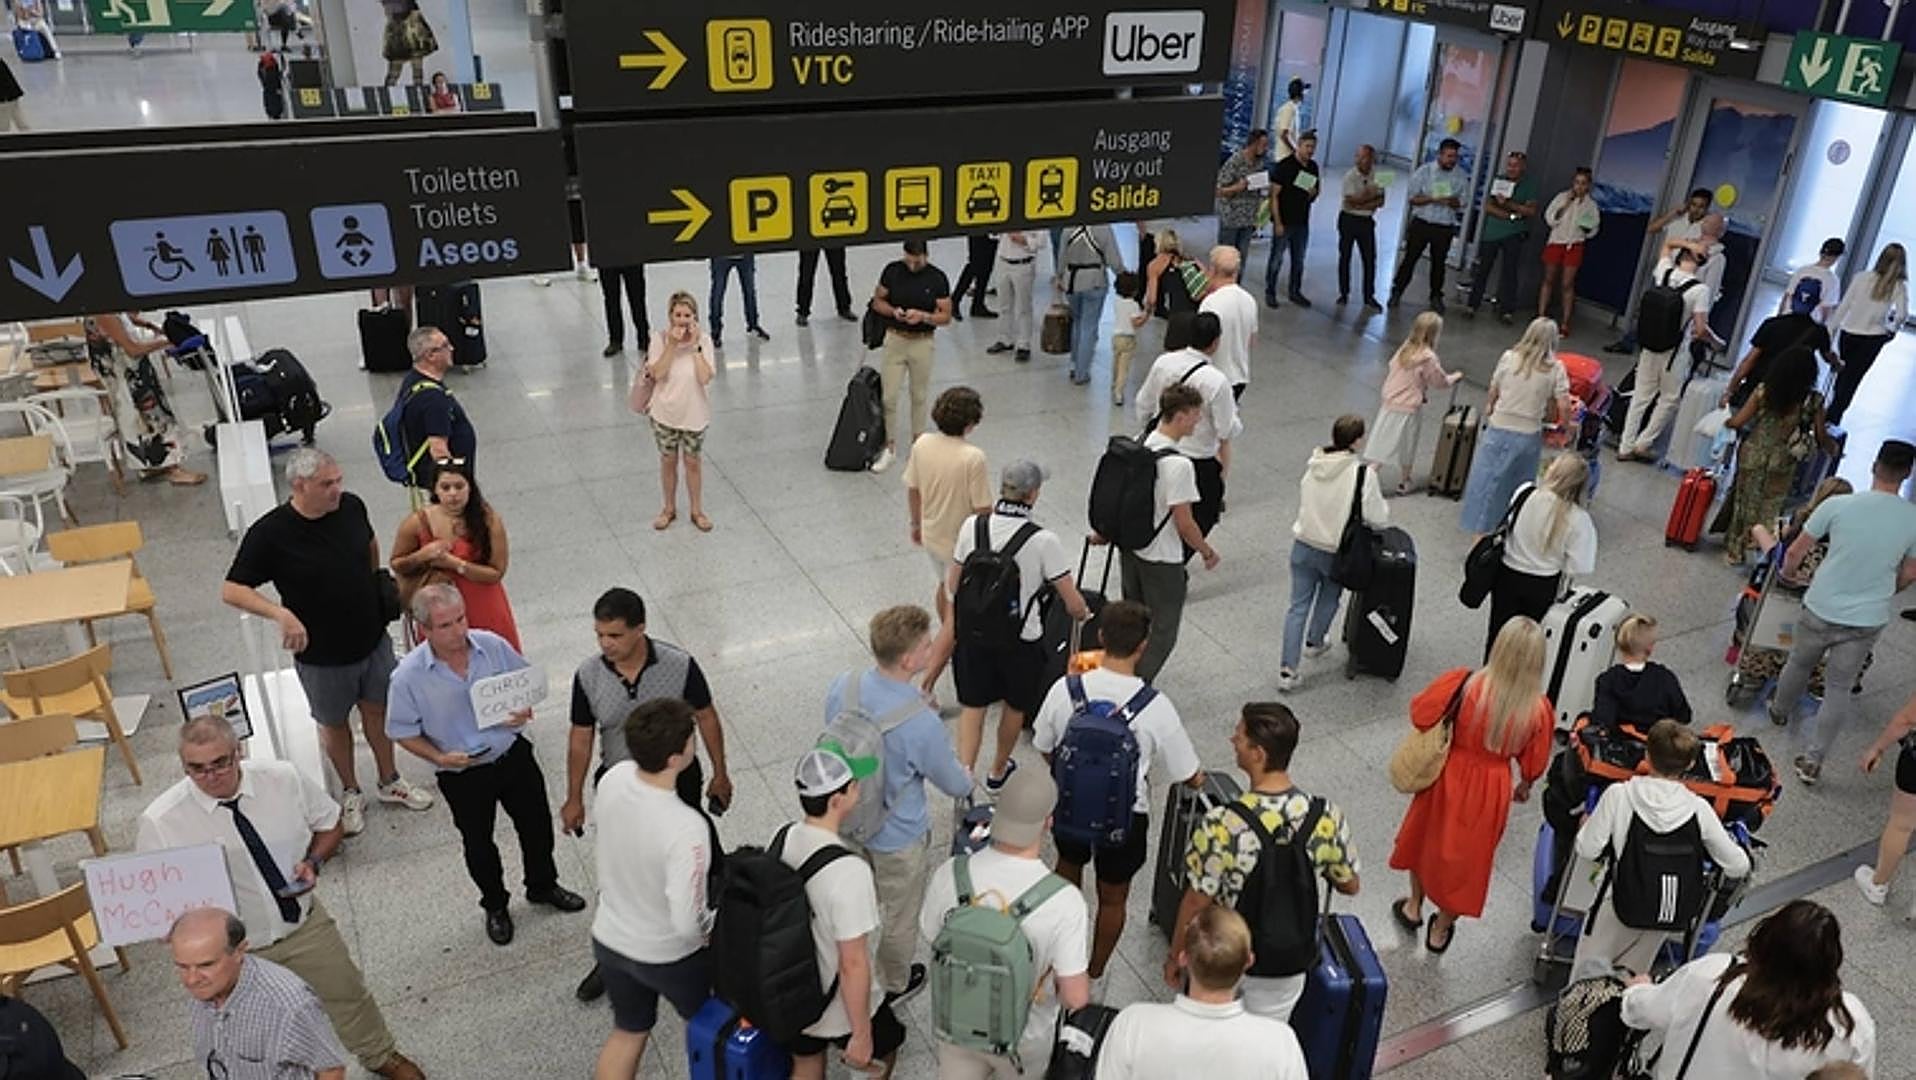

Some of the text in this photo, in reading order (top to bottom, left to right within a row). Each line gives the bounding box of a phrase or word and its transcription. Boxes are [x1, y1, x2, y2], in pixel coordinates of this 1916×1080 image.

[1050, 16, 1090, 40] APP
[1689, 17, 1737, 41] Ausgang
[1111, 24, 1195, 62] Uber
[1681, 48, 1715, 66] Salida
[790, 54, 854, 85] VTC
[1093, 127, 1171, 153] Ausgang
[403, 165, 519, 195] Toiletten
[969, 165, 1001, 181] TAXI
[1093, 156, 1163, 183] Way out
[747, 189, 778, 233] P
[1090, 182, 1161, 212] Salida
[410, 201, 498, 229] Toilets
[419, 237, 519, 267] Aseos
[480, 671, 530, 698] CHRIS
[97, 861, 184, 897] Hugh
